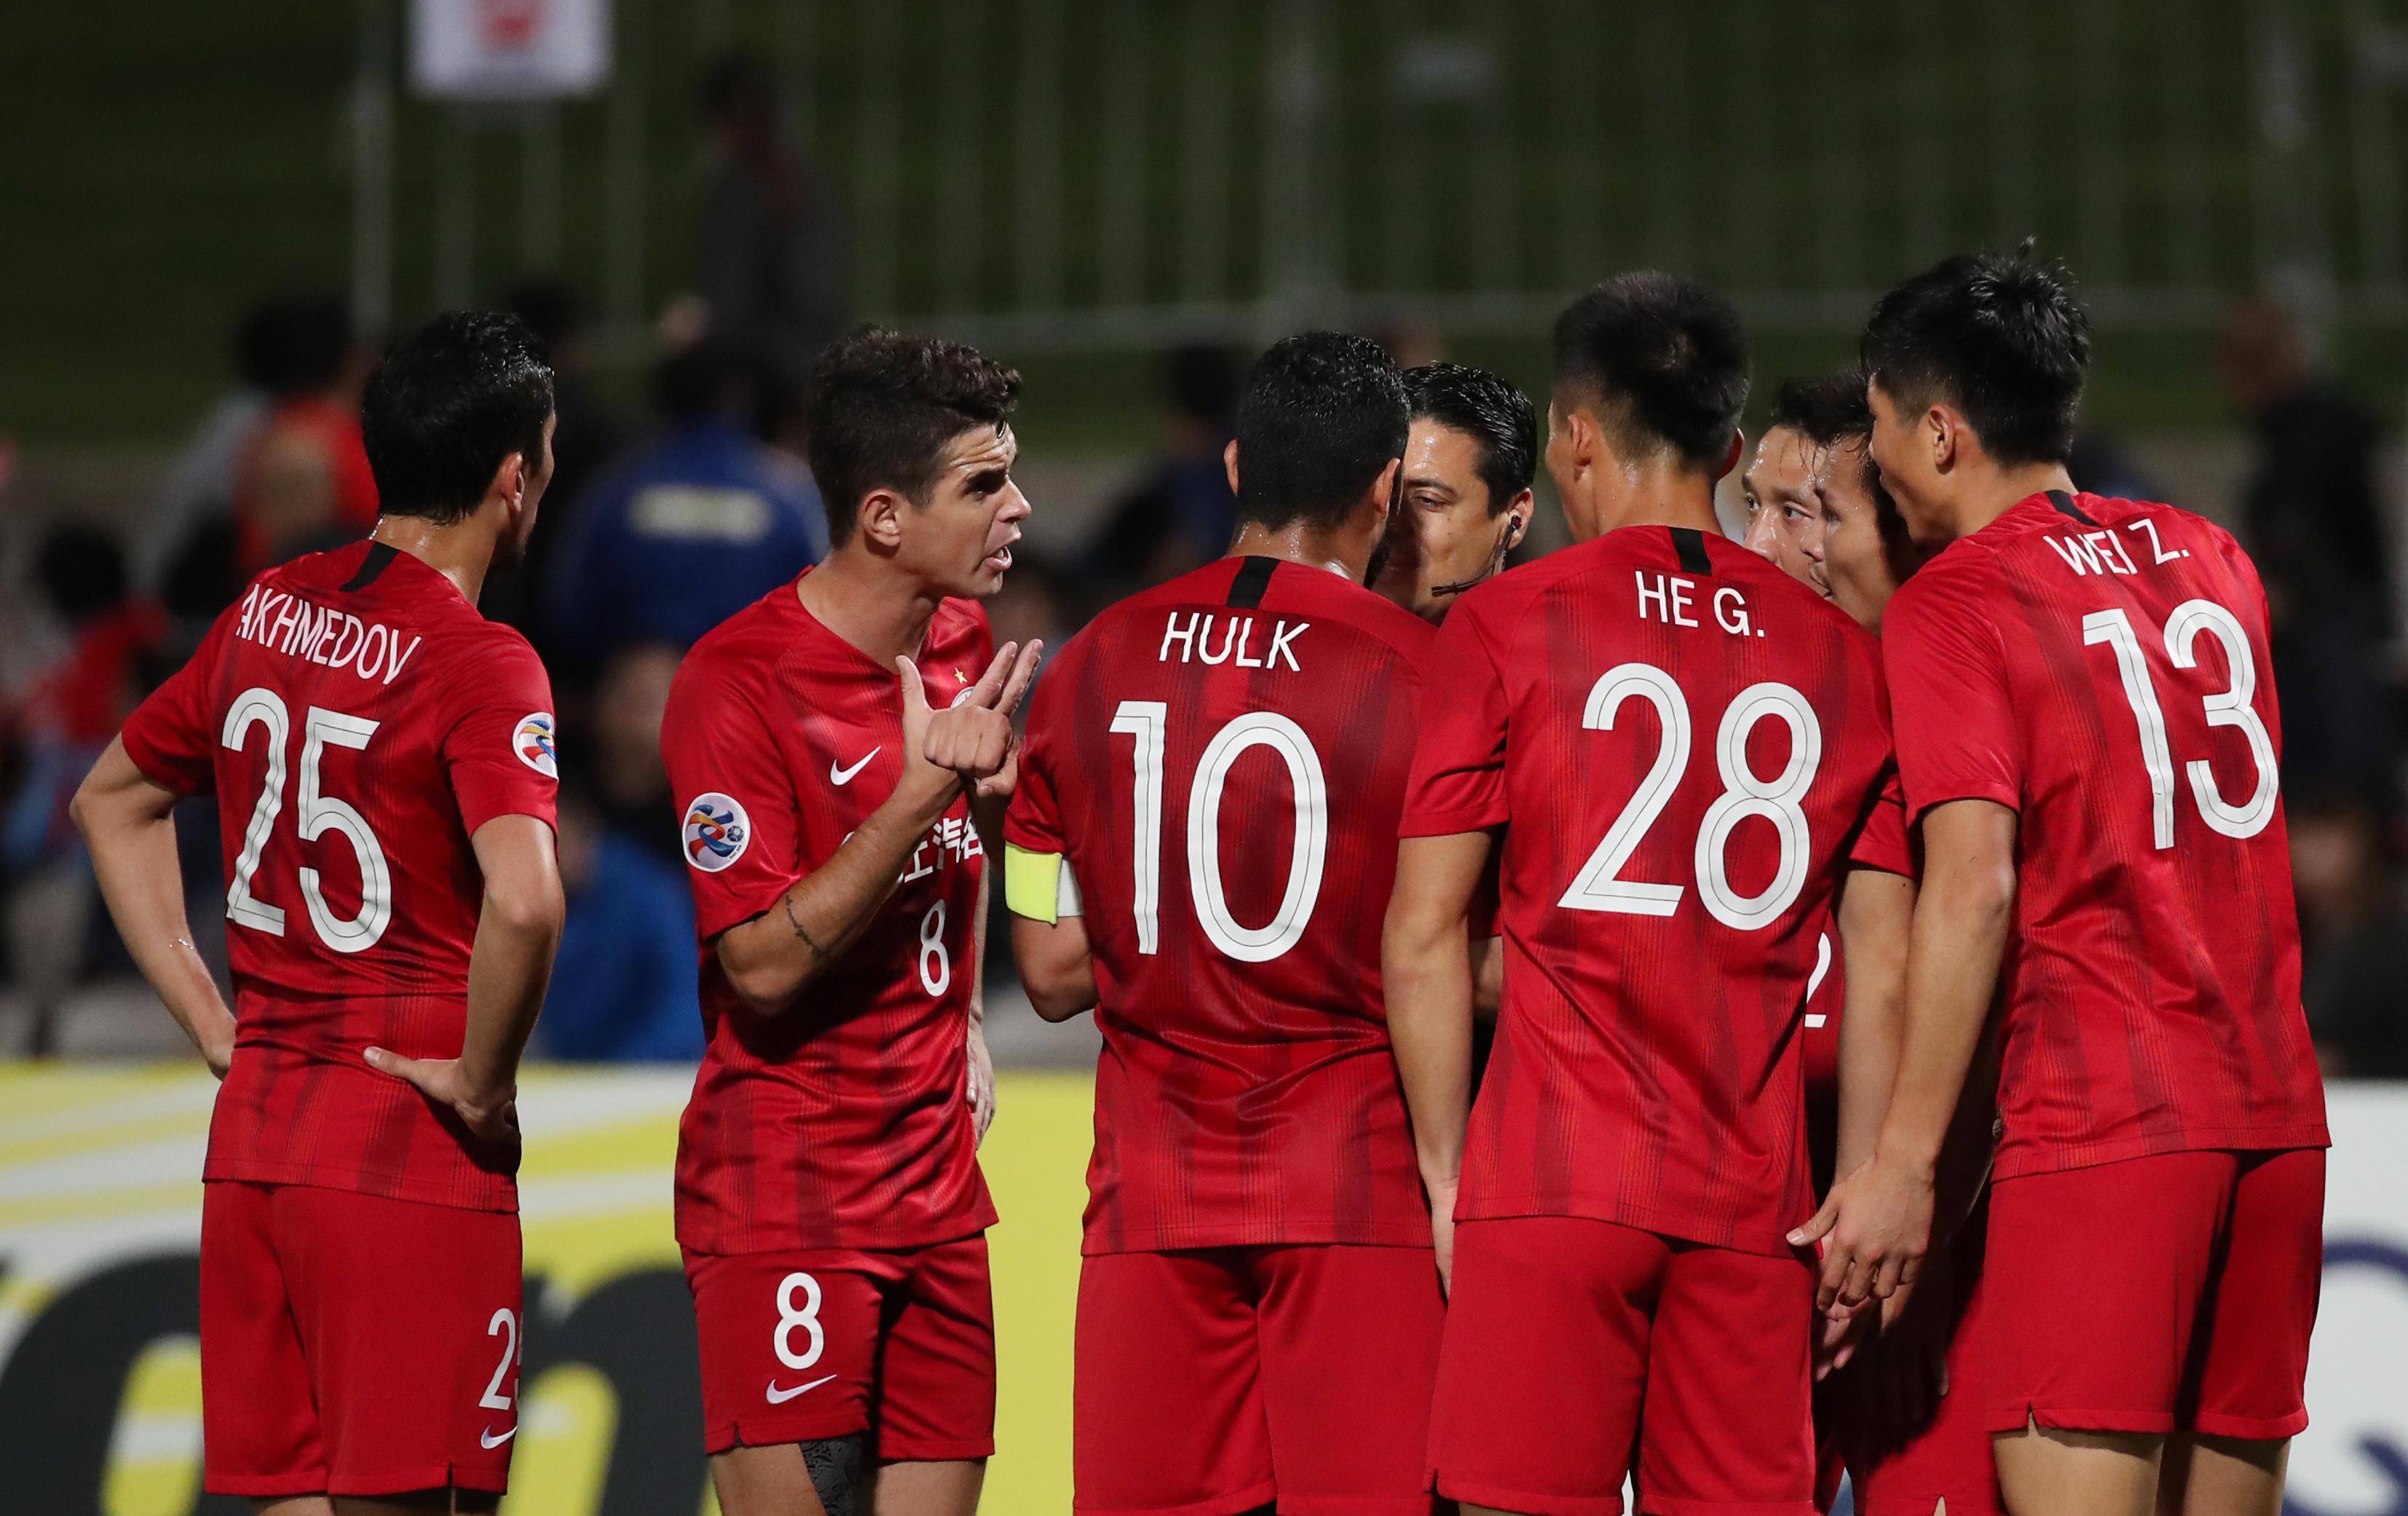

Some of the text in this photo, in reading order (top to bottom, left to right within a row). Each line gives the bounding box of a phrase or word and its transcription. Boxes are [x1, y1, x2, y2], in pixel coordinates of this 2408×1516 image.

[2043, 518, 2190, 576] WEI Z.
[235, 583, 422, 685] AKHMEDOV
[1158, 612, 1310, 672] HULK
[1635, 570, 1765, 637] HE G.
[2082, 599, 2279, 850] 13
[221, 687, 392, 953] 25
[1108, 700, 1328, 963] 10
[1557, 662, 1822, 931] 28
[918, 899, 950, 997] 8
[478, 1308, 523, 1411] 2
[773, 1272, 824, 1370] 8
